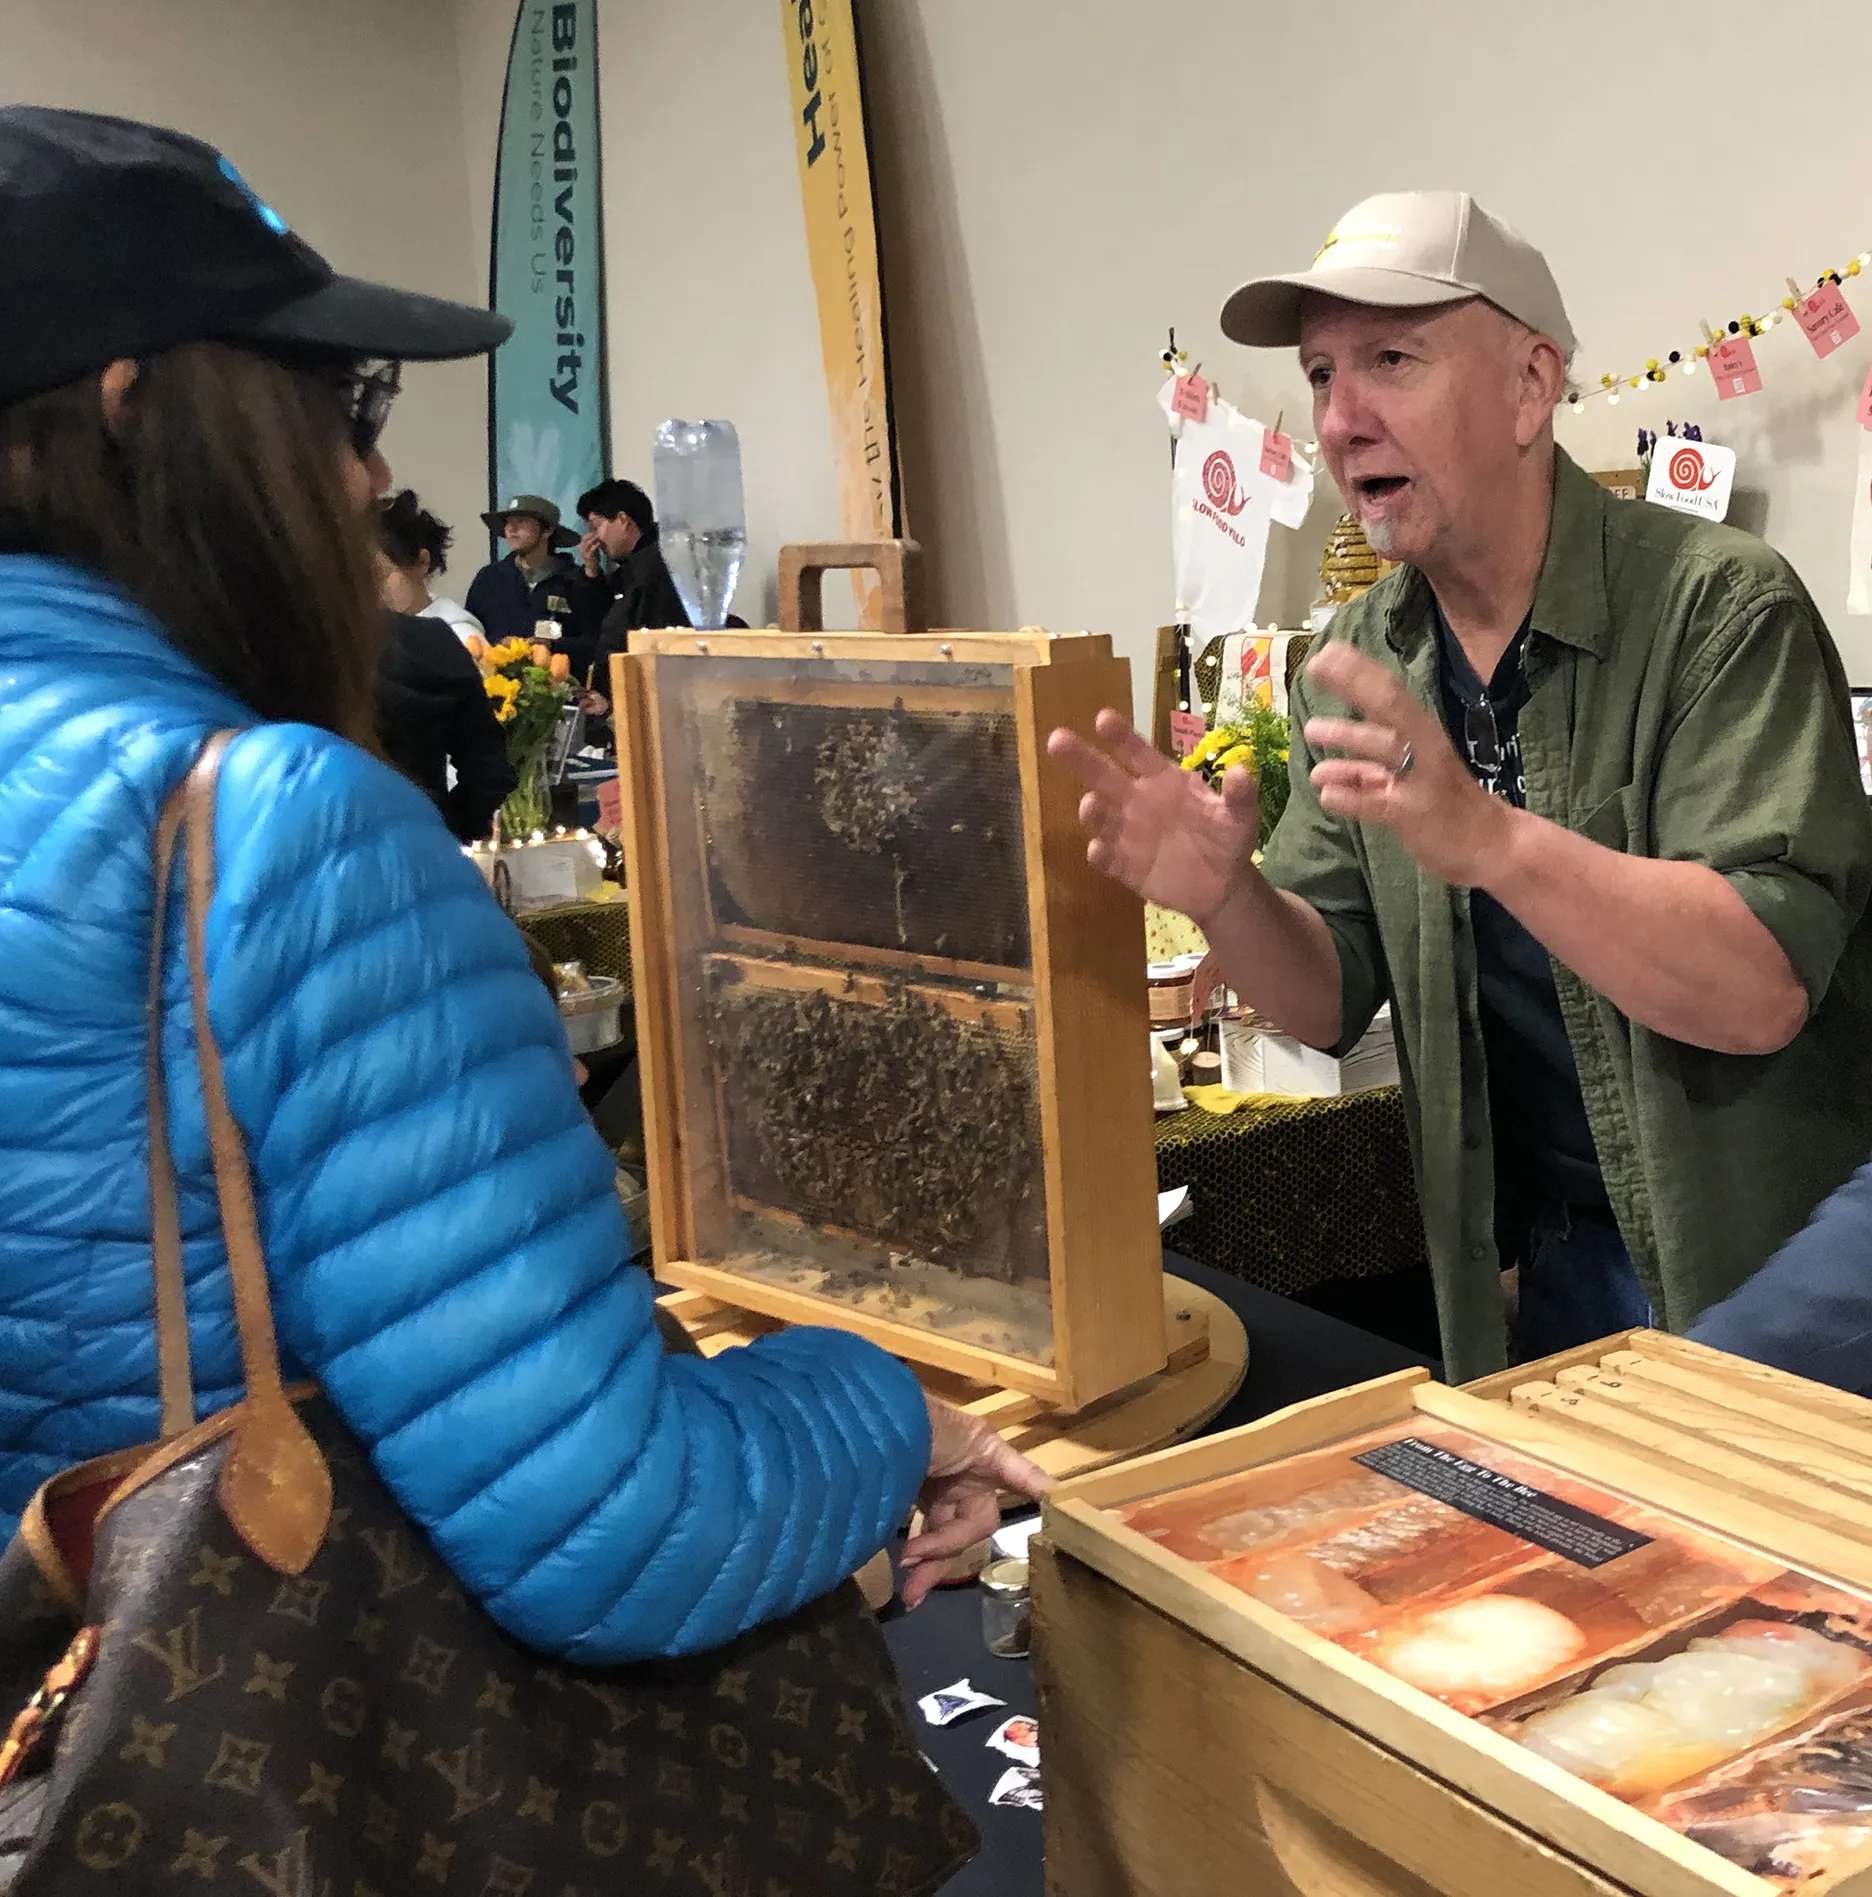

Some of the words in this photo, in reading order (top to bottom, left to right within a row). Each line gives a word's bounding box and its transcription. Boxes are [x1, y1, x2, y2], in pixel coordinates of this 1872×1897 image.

[530, 9, 545, 122] Nature
[791, 0, 826, 169] Hea
[530, 132, 546, 241] Needs
[550, 2, 584, 416] Biodiversity
[828, 91, 849, 220] Power
[530, 252, 547, 294] Us
[842, 226, 868, 388] Healing
[1403, 1437, 1435, 1455] From
[1433, 1450, 1456, 1464] The
[1476, 1469, 1494, 1480] To
[1491, 1475, 1516, 1490] The
